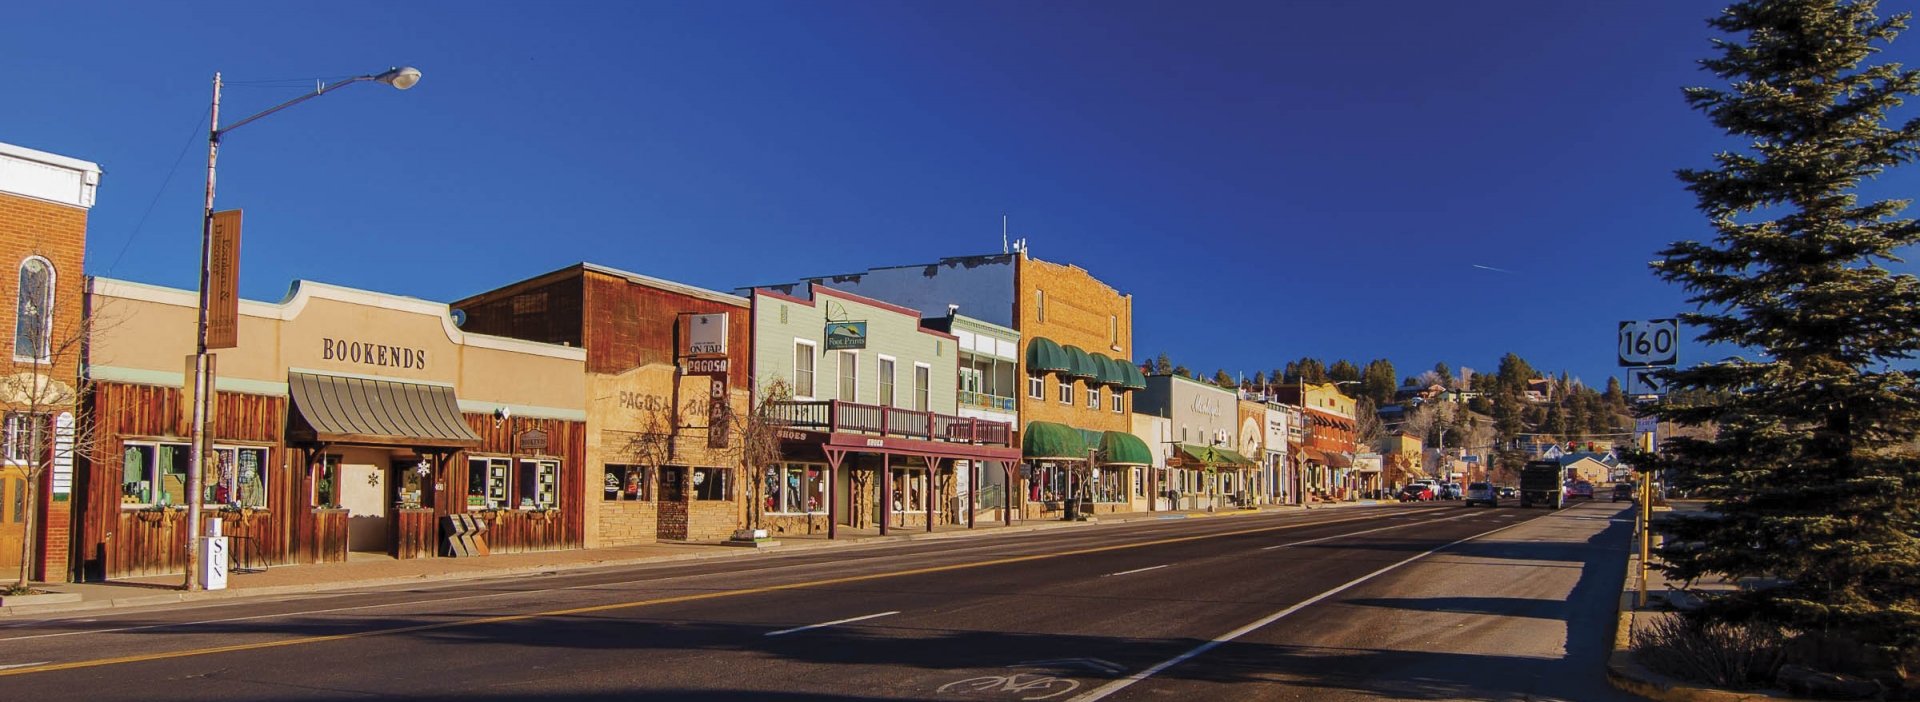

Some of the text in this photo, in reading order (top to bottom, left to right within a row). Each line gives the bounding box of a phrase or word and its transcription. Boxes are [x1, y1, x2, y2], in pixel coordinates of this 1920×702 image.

[220, 290, 230, 301] &
[829, 337, 865, 346] Foot Prints
[1626, 329, 1671, 355] 160
[323, 338, 425, 370] BOOKENDS
[690, 345, 722, 353] ON TAP
[688, 360, 727, 372] PAGOSA
[619, 390, 672, 413] PAGOSA
[776, 430, 807, 441] SHOES
[214, 539, 223, 578] SUN
